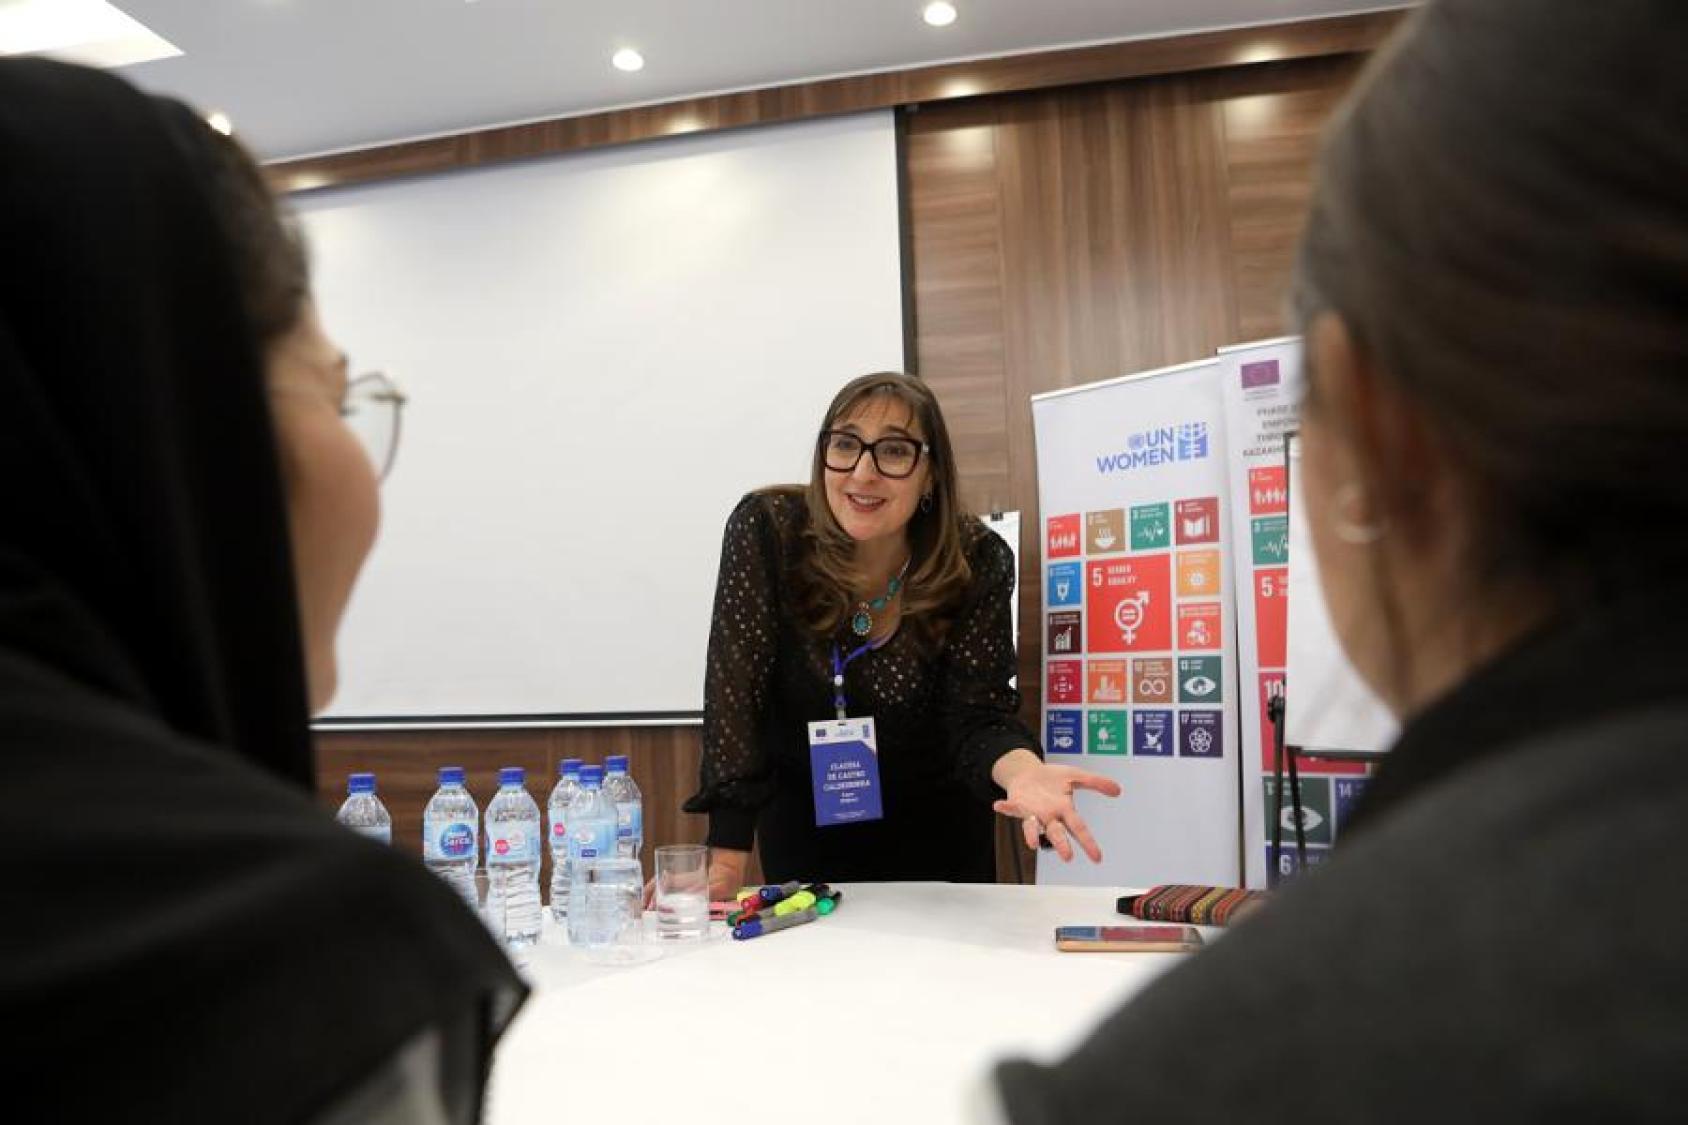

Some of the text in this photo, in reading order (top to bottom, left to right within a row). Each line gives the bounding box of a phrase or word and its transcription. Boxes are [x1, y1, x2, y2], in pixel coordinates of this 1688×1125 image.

[1146, 427, 1174, 447] UN
[1096, 446, 1174, 473] WOMEN
[1093, 567, 1103, 587] 5
[1261, 576, 1273, 598] 5
